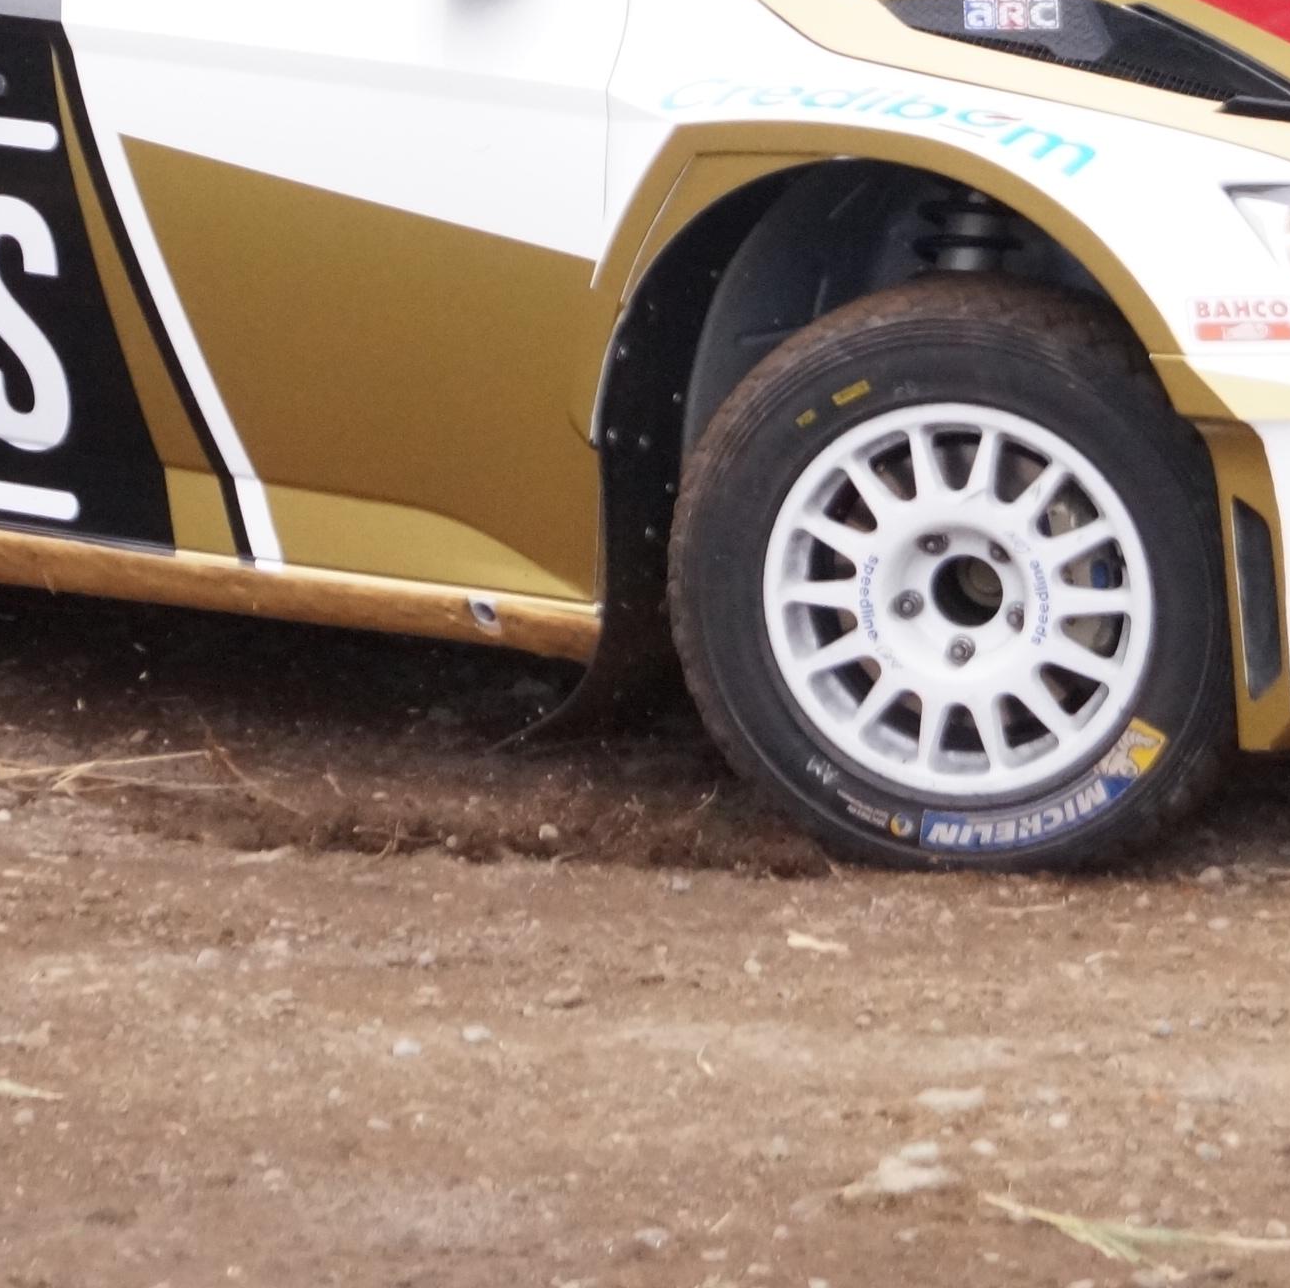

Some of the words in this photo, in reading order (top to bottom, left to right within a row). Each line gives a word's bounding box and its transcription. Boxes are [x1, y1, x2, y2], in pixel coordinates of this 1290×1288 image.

[1195, 299, 1289, 319] BAHCO
[860, 555, 880, 642] speedline
[1029, 559, 1049, 646] speedline
[925, 779, 1108, 845] MICHELIN
